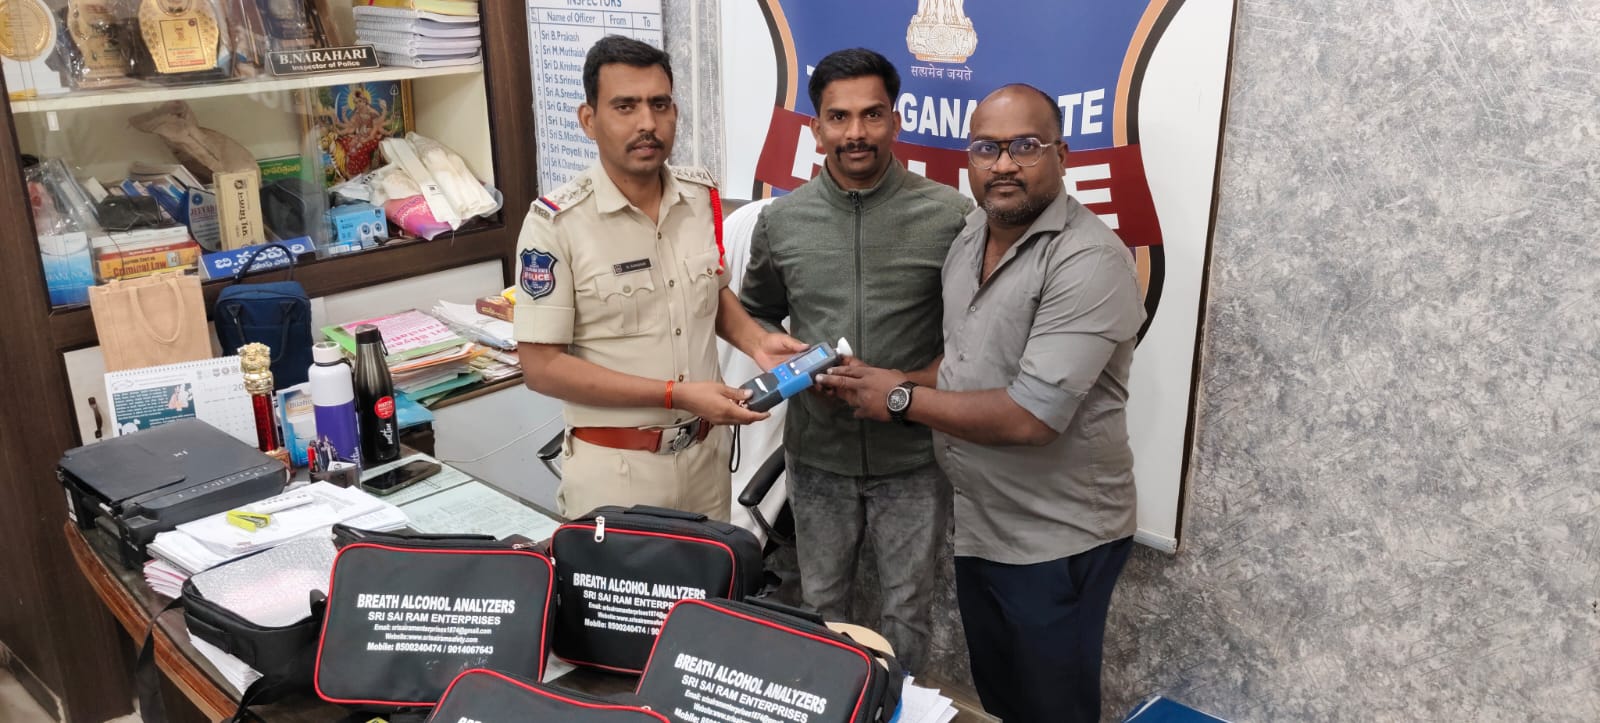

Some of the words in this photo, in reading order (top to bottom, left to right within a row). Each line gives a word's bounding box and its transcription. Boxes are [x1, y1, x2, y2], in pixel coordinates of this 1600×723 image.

[547, 12, 565, 21] Name
[567, 13, 573, 21] of
[574, 13, 595, 23] Officer
[609, 15, 626, 25] From
[643, 16, 651, 27] To
[541, 30, 549, 40] Sri
[280, 49, 367, 65] B.NARAHARI
[291, 63, 327, 71] Inspector
[544, 60, 552, 70] Sri
[911, 64, 944, 79] सत्यमेव
[946, 65, 973, 81] जयते
[544, 75, 553, 83] Sri
[546, 87, 554, 96] Sri
[547, 101, 555, 110] Sri
[548, 116, 557, 126] Sri
[549, 129, 558, 140] Sri
[550, 144, 559, 153] Sri
[552, 172, 561, 182] Sri
[113, 262, 149, 277] Criminal
[151, 260, 167, 270] Law
[573, 572, 607, 591] BREATH
[608, 578, 651, 596] ALCOHOL
[652, 583, 707, 600] ANALYZERS
[356, 593, 400, 609] BREATH
[401, 595, 452, 611] ALCOHOL
[453, 598, 516, 614] ANALYZERS
[583, 590, 597, 600] SRI
[598, 592, 611, 602] SAI
[612, 594, 633, 606] RAM
[634, 597, 675, 611] ENTERPR
[368, 611, 385, 621] SRI
[387, 612, 404, 622] SAI
[405, 613, 429, 623] RAM
[431, 614, 501, 625] ENTERPRISES
[584, 618, 607, 629] Mobile:
[367, 642, 394, 651] Mobile:
[395, 642, 443, 653] 8500240474
[447, 645, 494, 655] 9014067643
[674, 652, 716, 678] BREATH
[714, 665, 764, 695] ALCOHOL
[764, 682, 827, 715] ANALYZERS
[682, 674, 699, 688] SRI
[700, 680, 715, 693] SAI
[715, 685, 739, 701] RAM
[739, 693, 809, 723] ENTERPRISES
[674, 707, 700, 723] Mobile:
